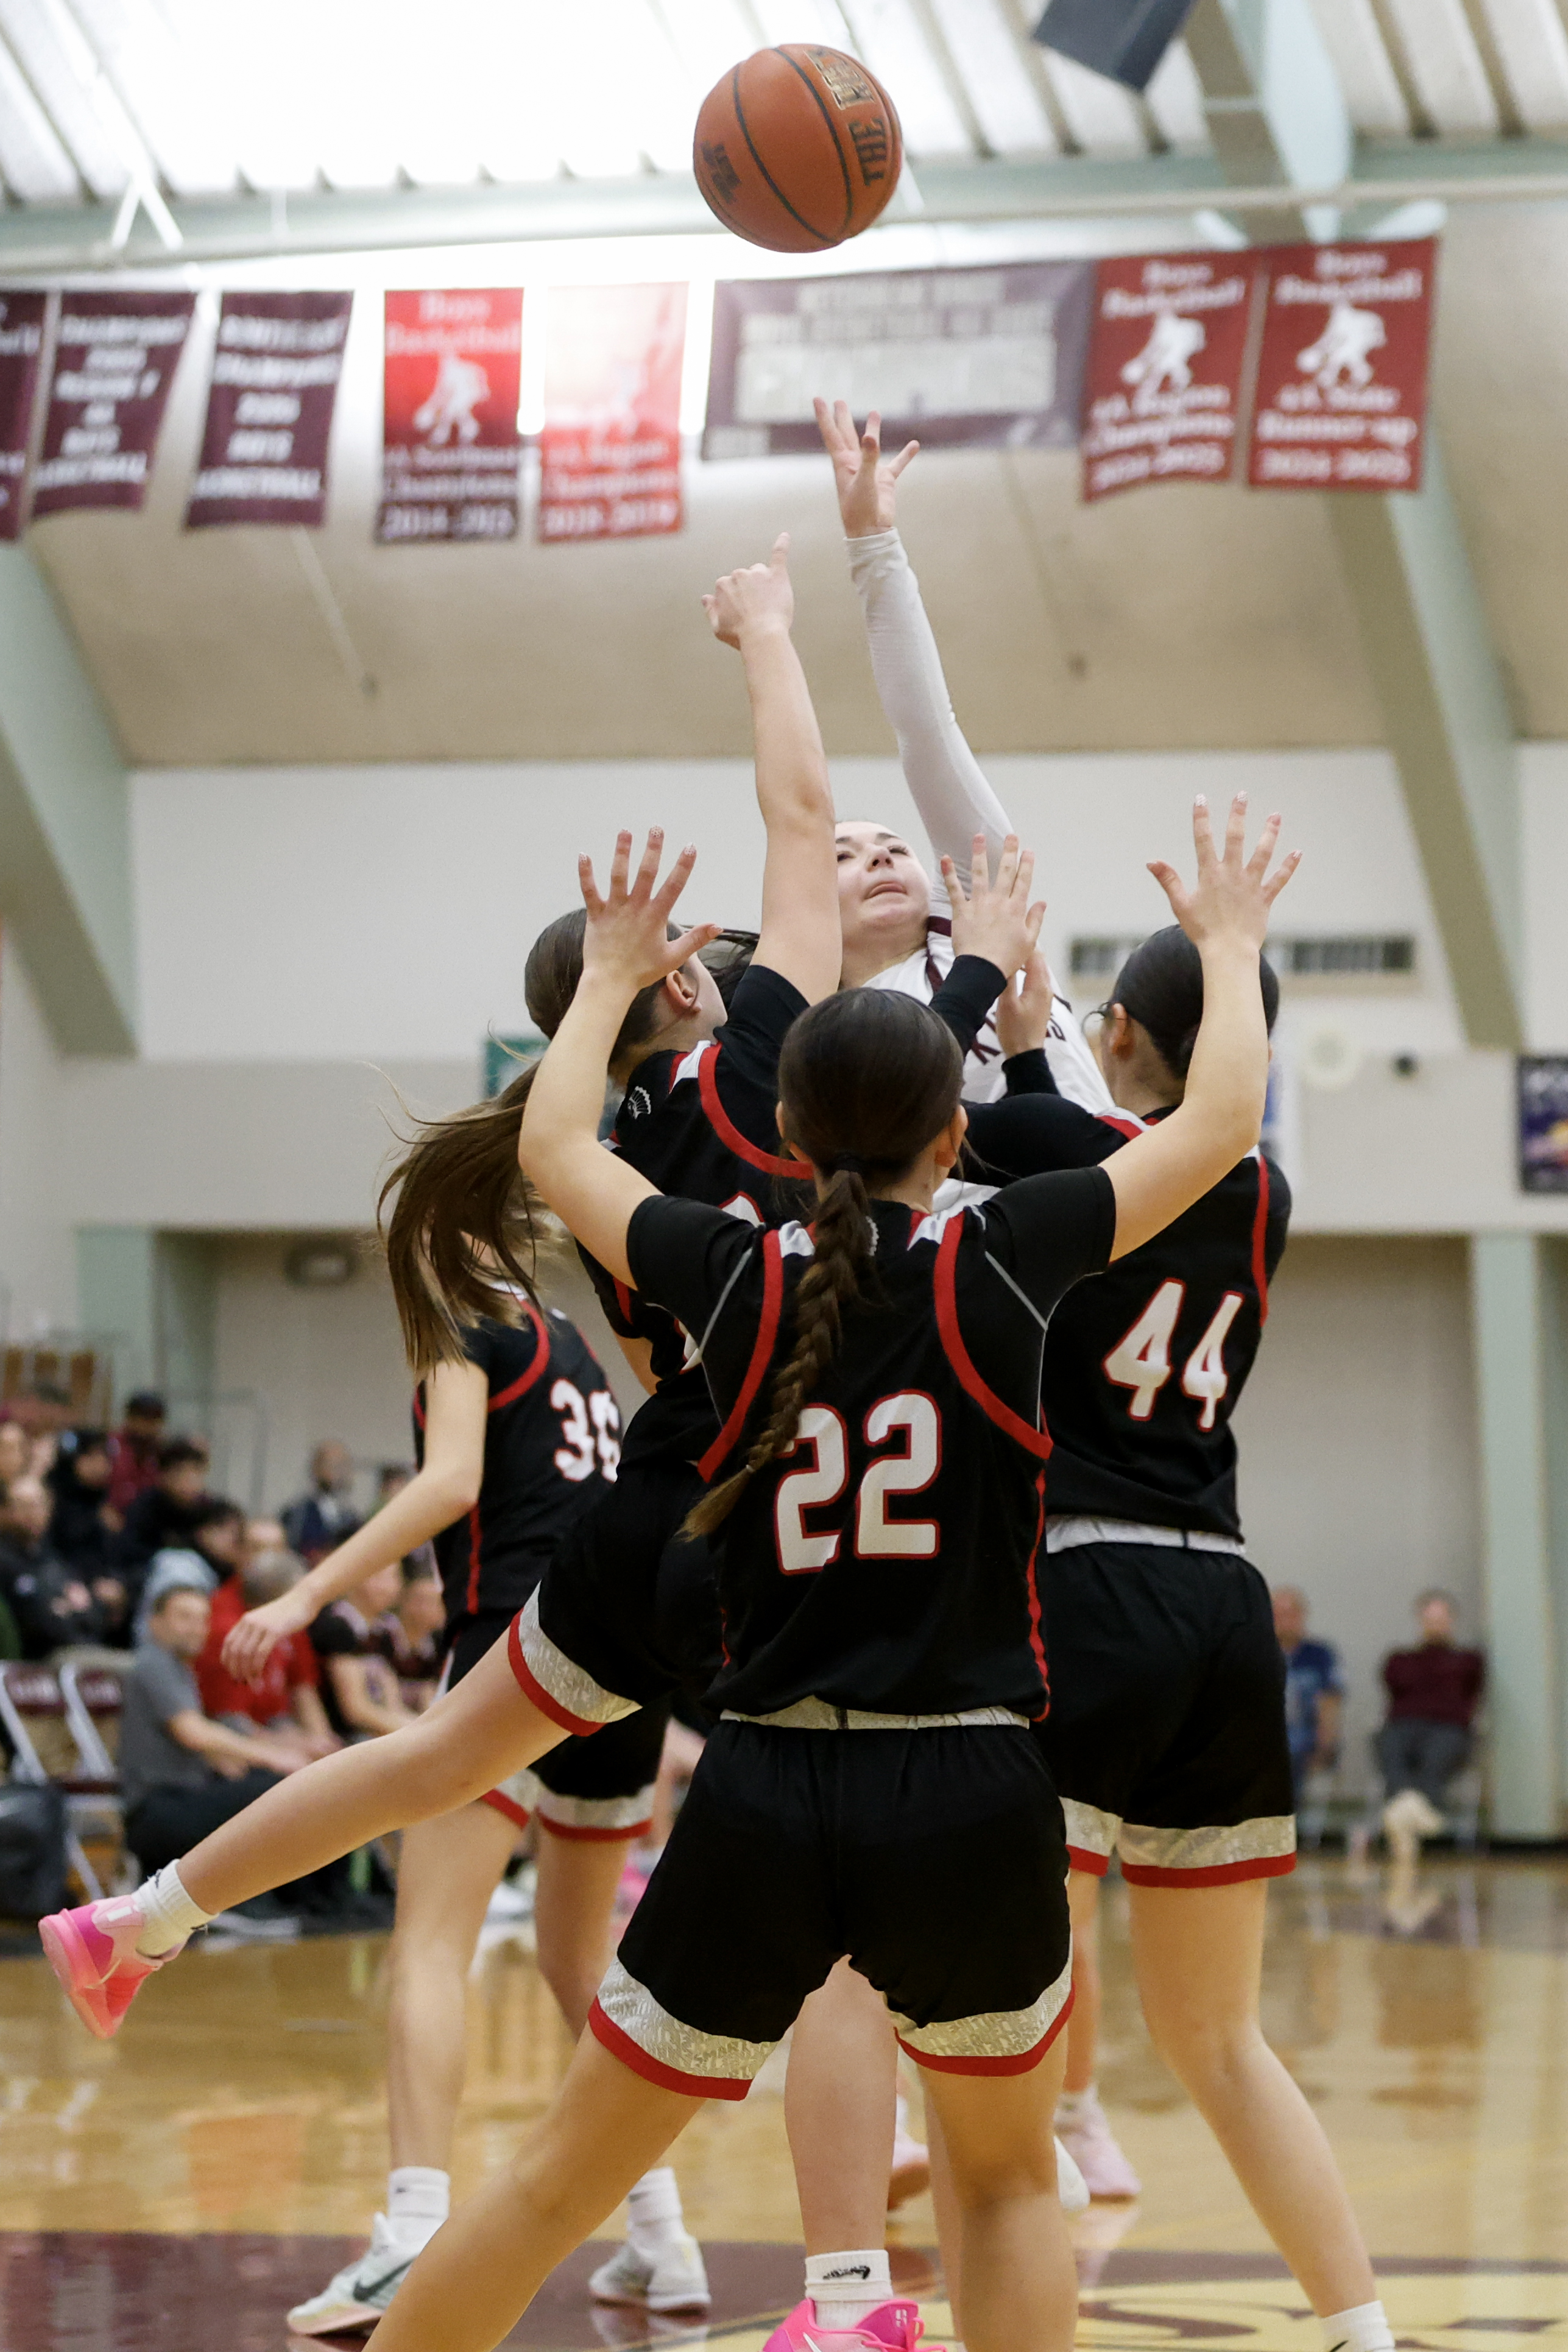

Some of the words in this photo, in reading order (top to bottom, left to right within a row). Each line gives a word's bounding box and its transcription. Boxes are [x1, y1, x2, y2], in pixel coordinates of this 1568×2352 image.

[848, 117, 887, 186] THE
[1103, 1277, 1244, 1432] 44
[774, 1389, 942, 1575] 22
